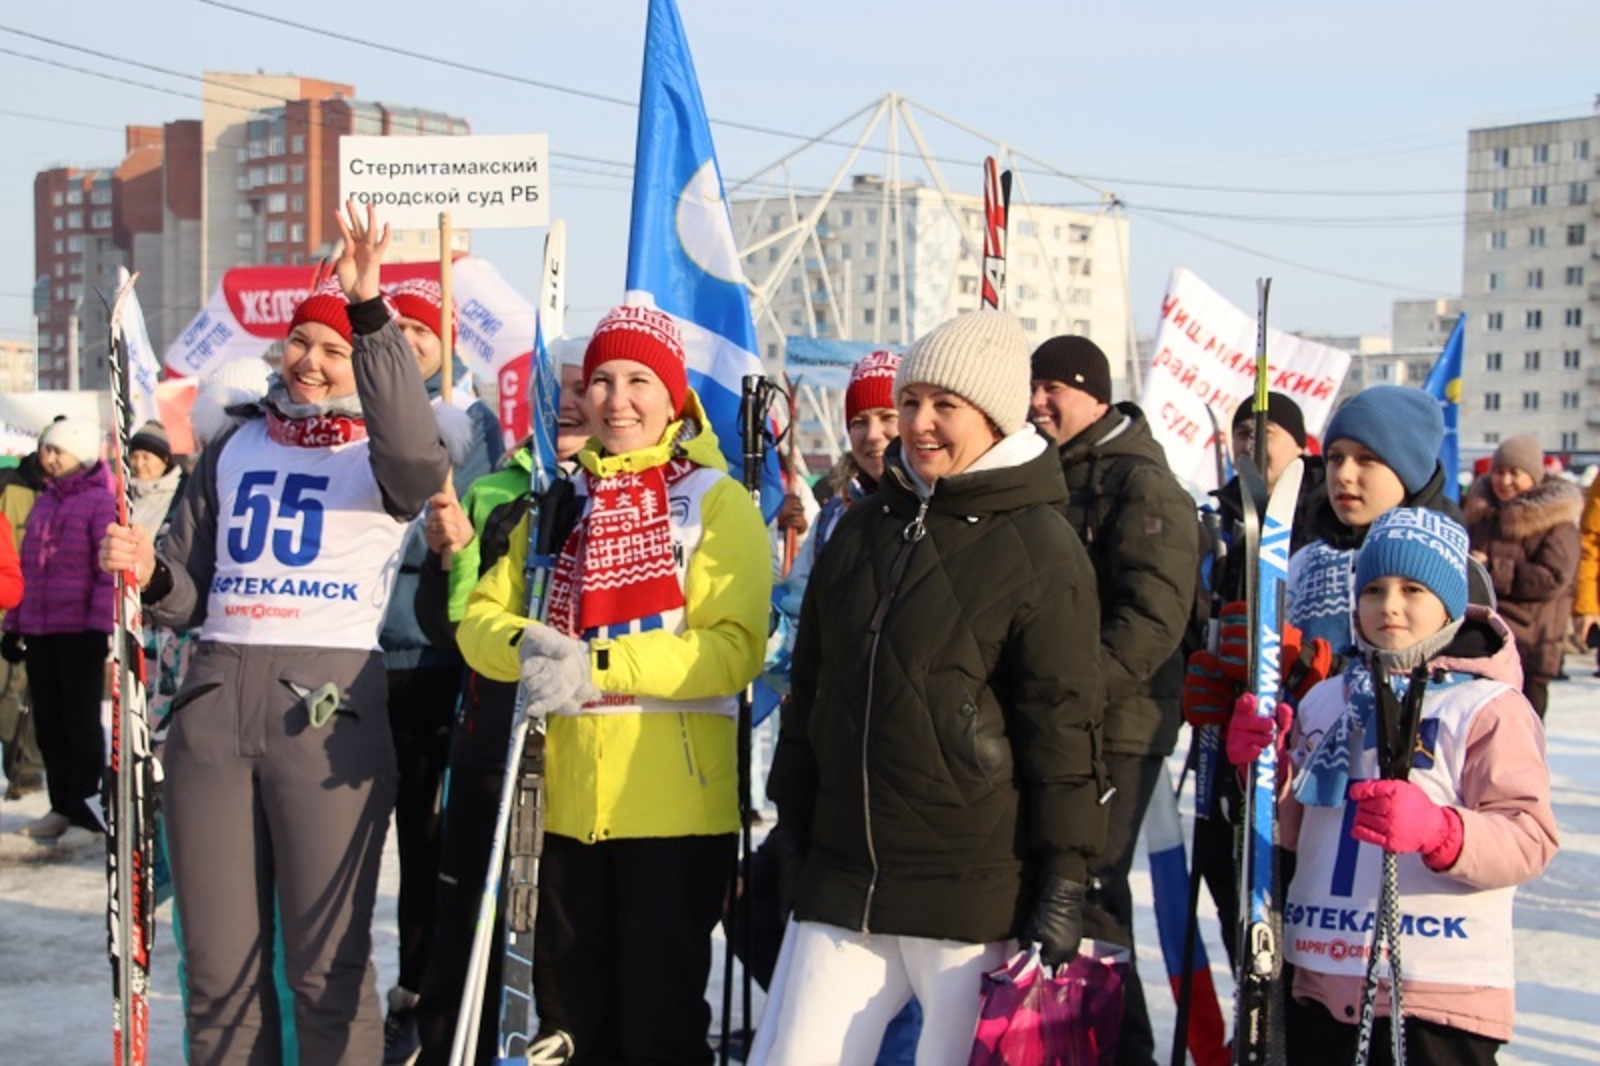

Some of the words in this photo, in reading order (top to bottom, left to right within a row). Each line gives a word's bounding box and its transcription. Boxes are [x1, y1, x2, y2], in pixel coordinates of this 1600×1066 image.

[349, 156, 538, 179] Стерлитамакский
[349, 187, 460, 207] городской
[467, 190, 504, 208] суд
[511, 185, 539, 203] РБ
[227, 470, 330, 566] 55
[1256, 624, 1281, 790] NODWAY
